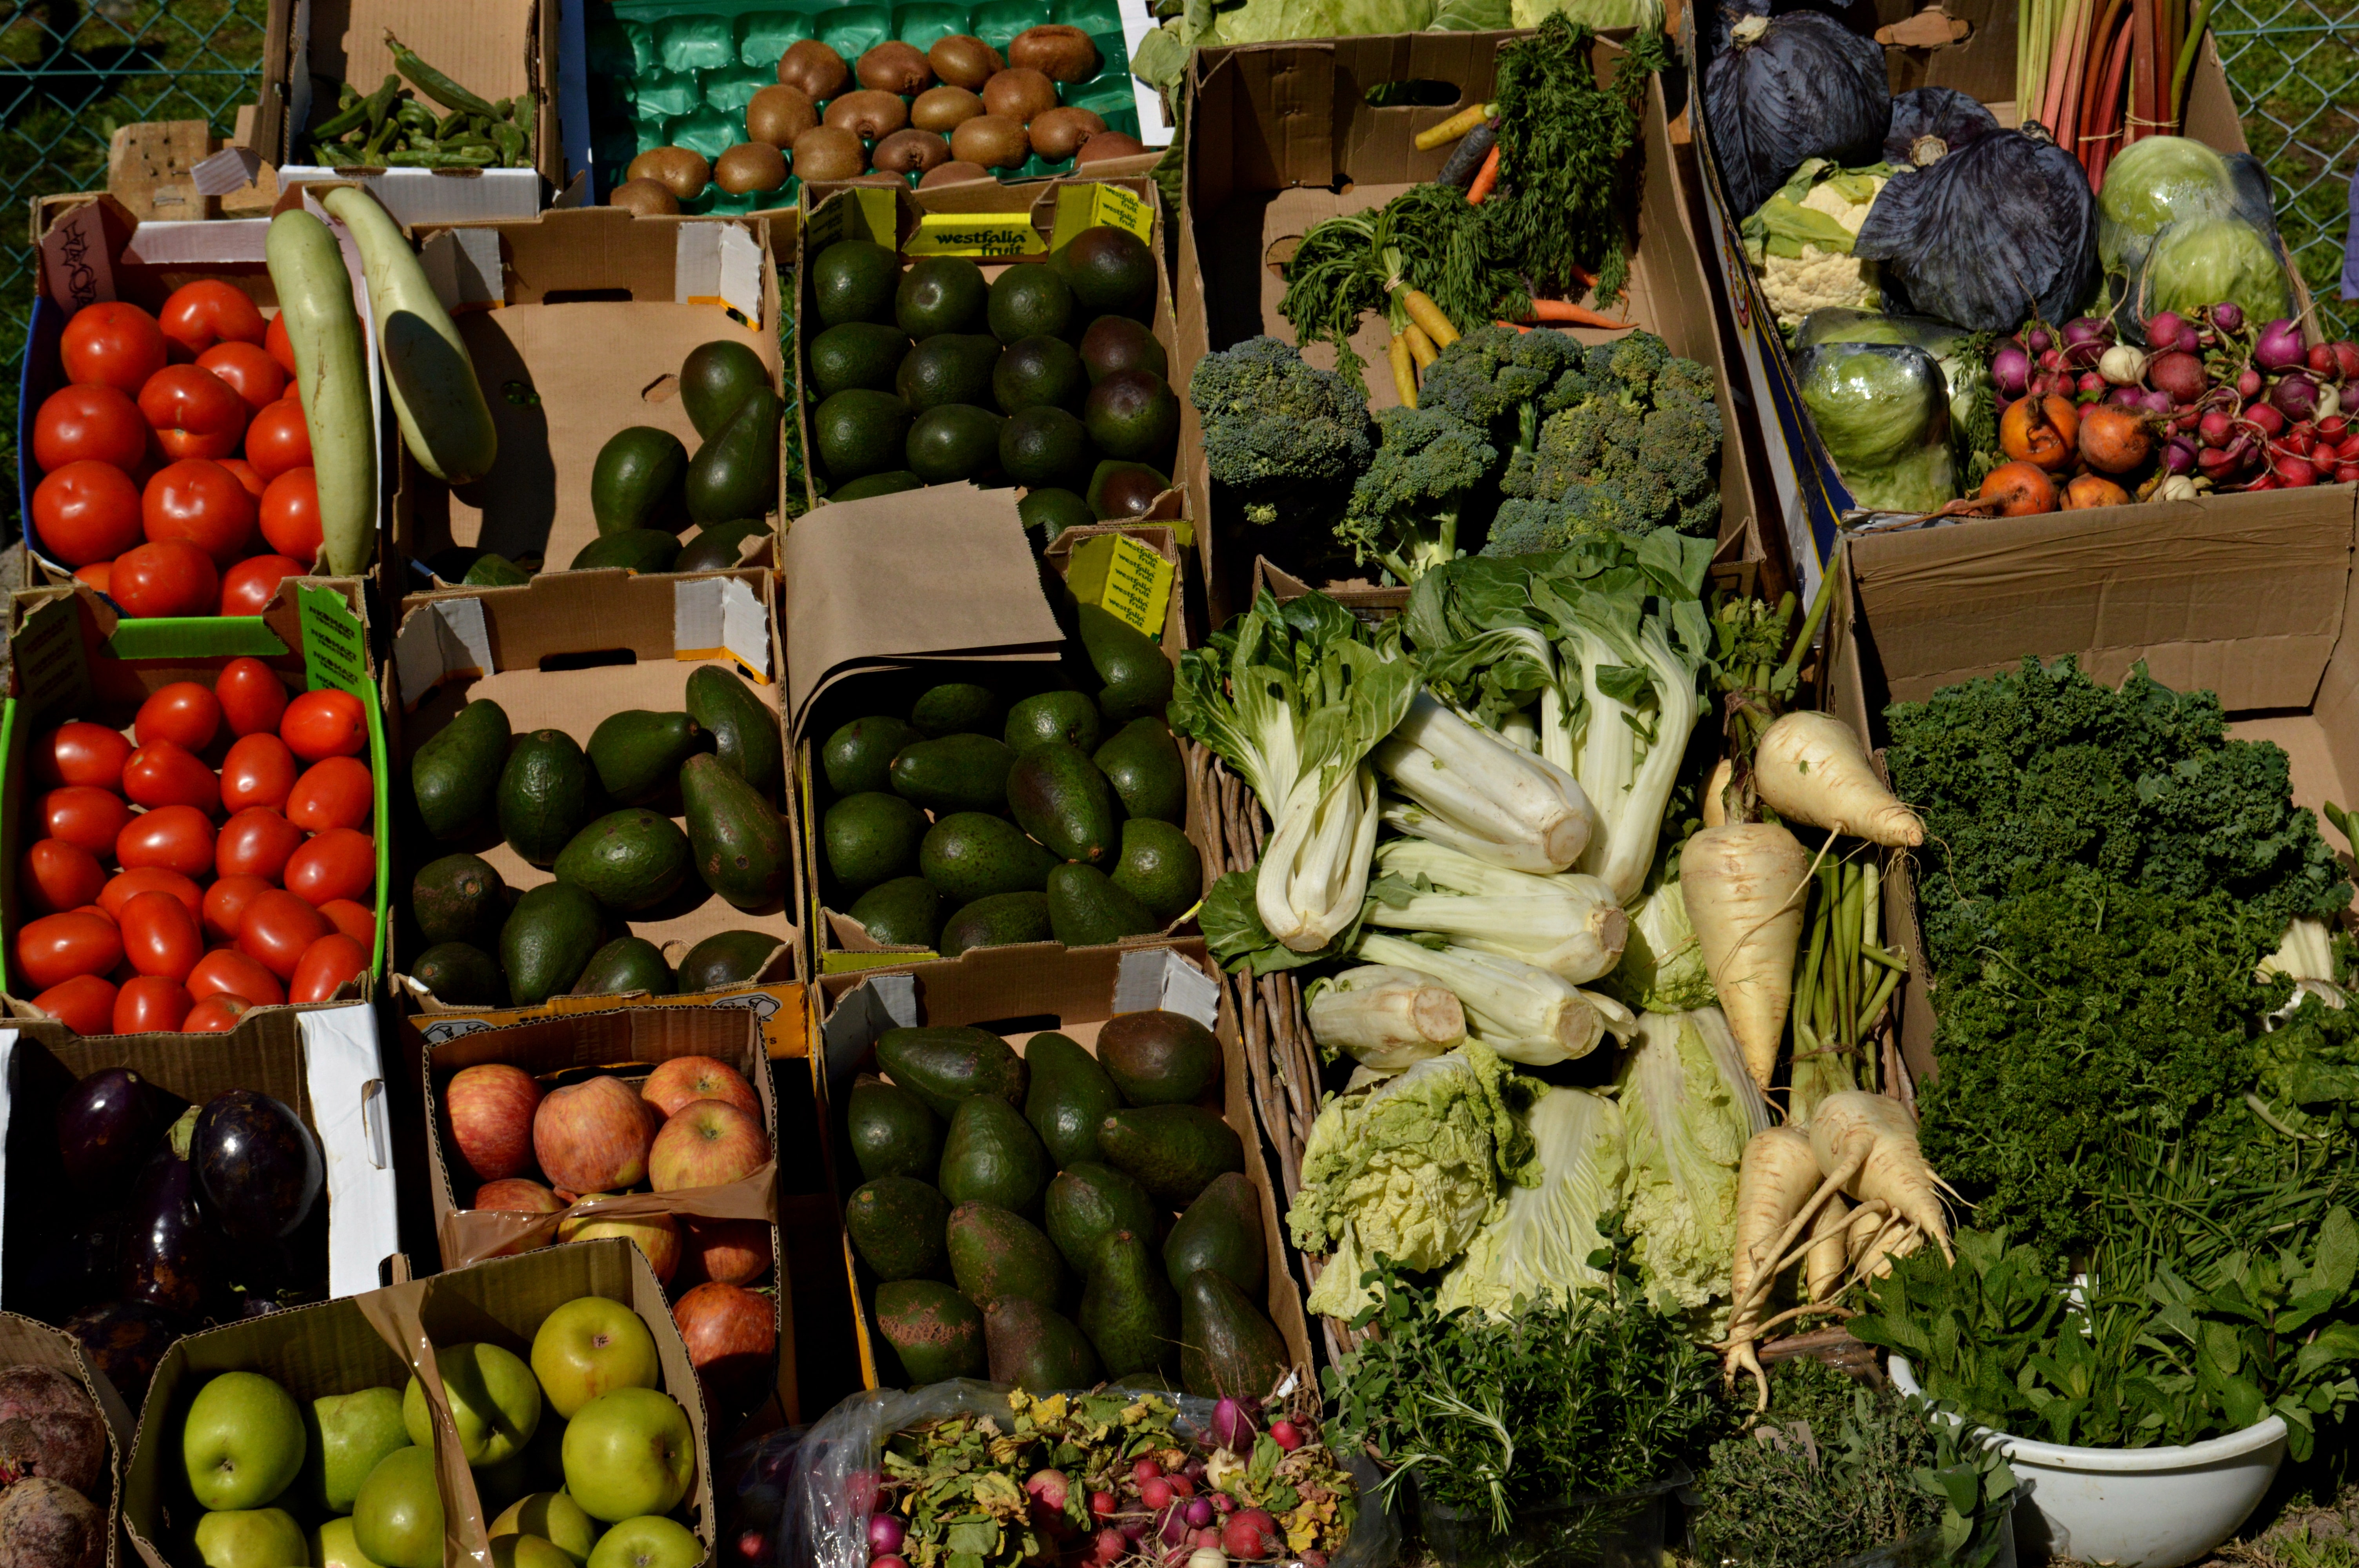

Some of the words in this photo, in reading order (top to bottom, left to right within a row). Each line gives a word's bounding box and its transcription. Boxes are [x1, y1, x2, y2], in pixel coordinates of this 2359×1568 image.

[1105, 186, 1139, 207] westfalia
[1121, 200, 1137, 213] fruit
[1102, 202, 1136, 224] westfalia
[1119, 217, 1135, 229] fruit
[935, 230, 1026, 244] westfalia
[981, 244, 1024, 256] fruit
[1121, 539, 1158, 563] westfalia
[1139, 554, 1156, 568] fruit
[1118, 554, 1154, 578] westfalia
[1136, 569, 1153, 584] fruit
[1115, 568, 1151, 593] westfalia
[1112, 583, 1148, 608] westfalia
[1132, 584, 1150, 599] fruit
[1109, 598, 1145, 622] westfalia
[1129, 599, 1146, 613] fruit
[309, 606, 355, 638] NKOMAZI
[1126, 613, 1143, 628] fruit
[311, 628, 357, 661] NKOMAZI
[313, 650, 359, 683] NKOMAZI
